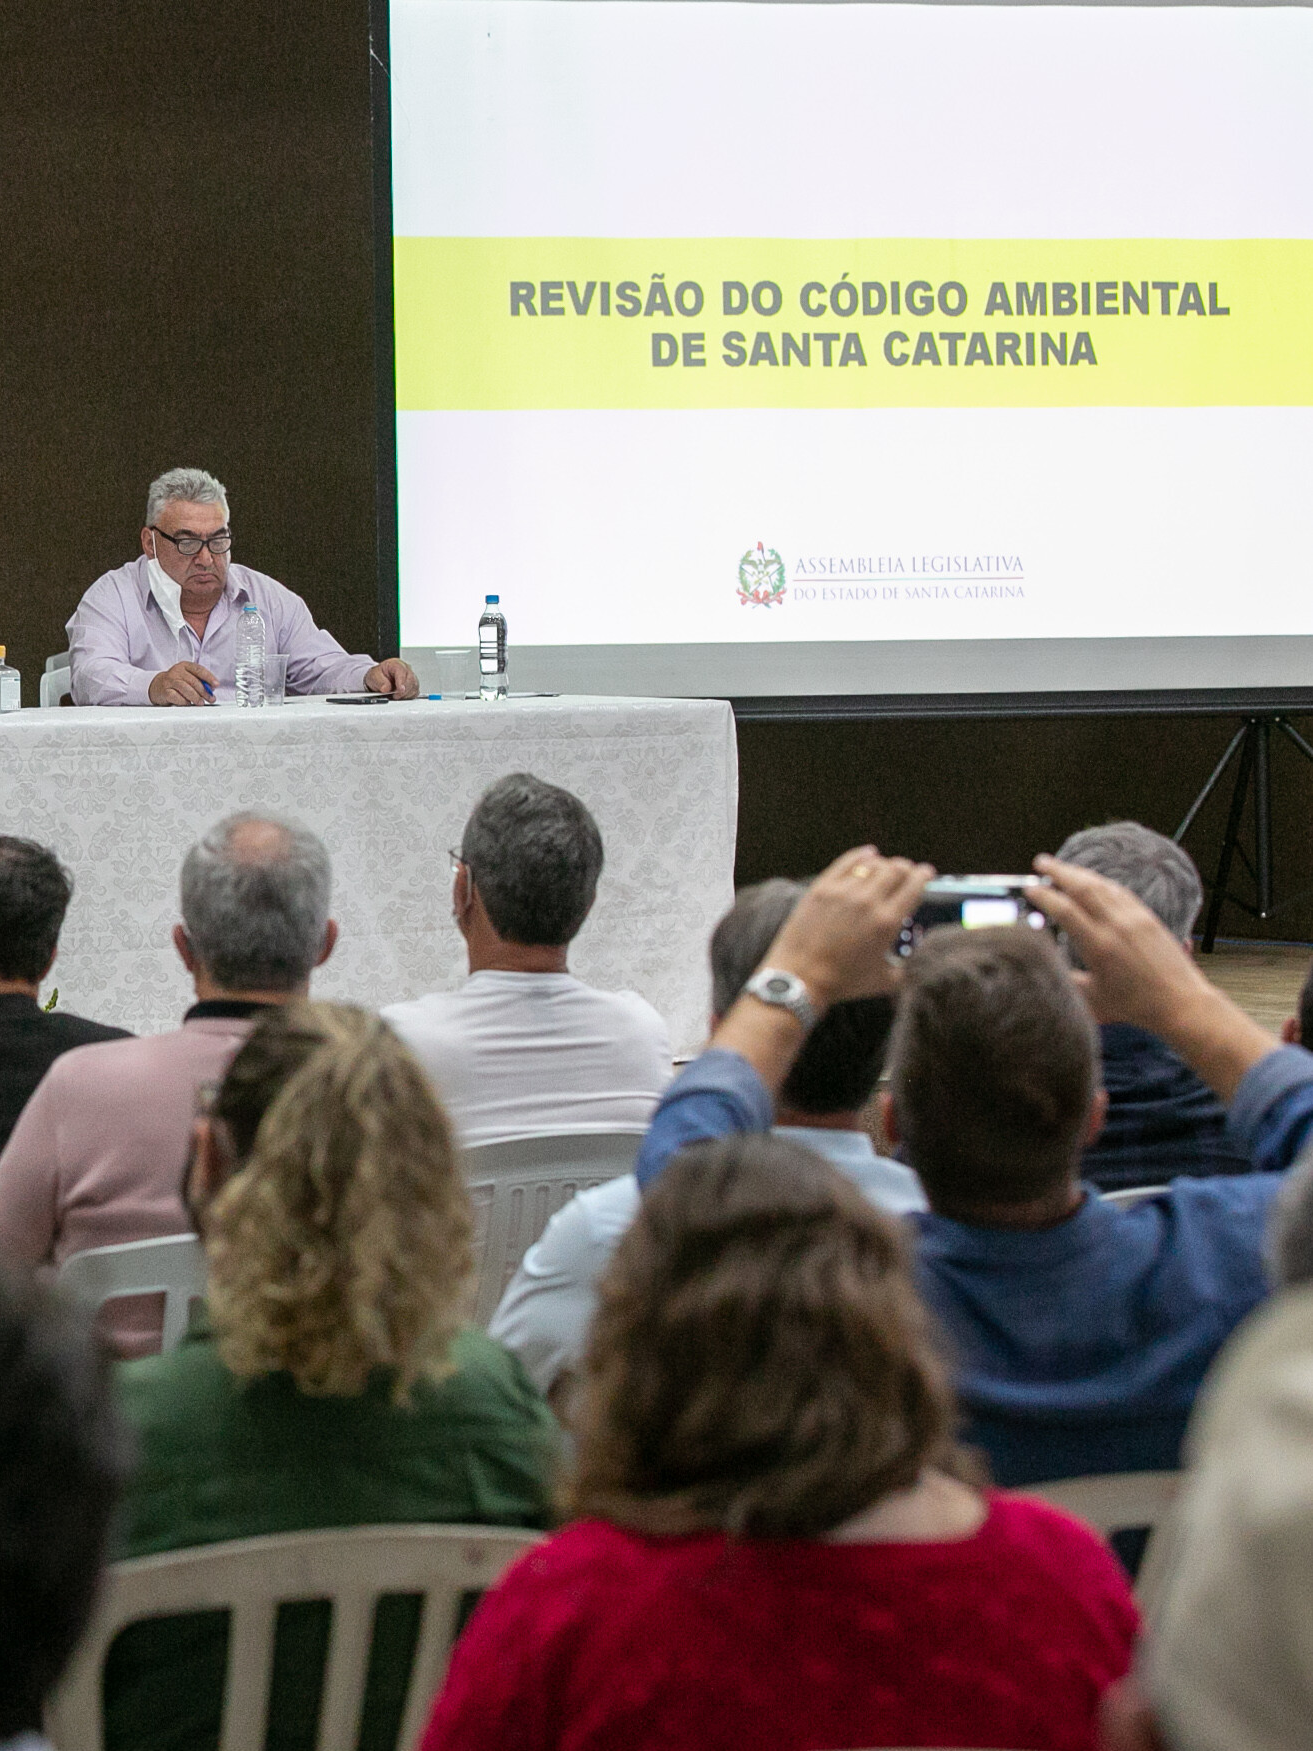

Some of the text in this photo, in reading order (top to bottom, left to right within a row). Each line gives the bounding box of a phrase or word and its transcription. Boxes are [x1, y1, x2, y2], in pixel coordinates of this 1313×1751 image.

[510, 273, 1231, 317] REVISÃO DO CÓDIGO AMBIENTAL
[651, 331, 1098, 367] DE SANTA CATARINA
[795, 556, 1024, 574] ASSEMBLEIA LEGISLATIVA
[794, 585, 1025, 600] DO ESTADO DE SANTA CATARINA
